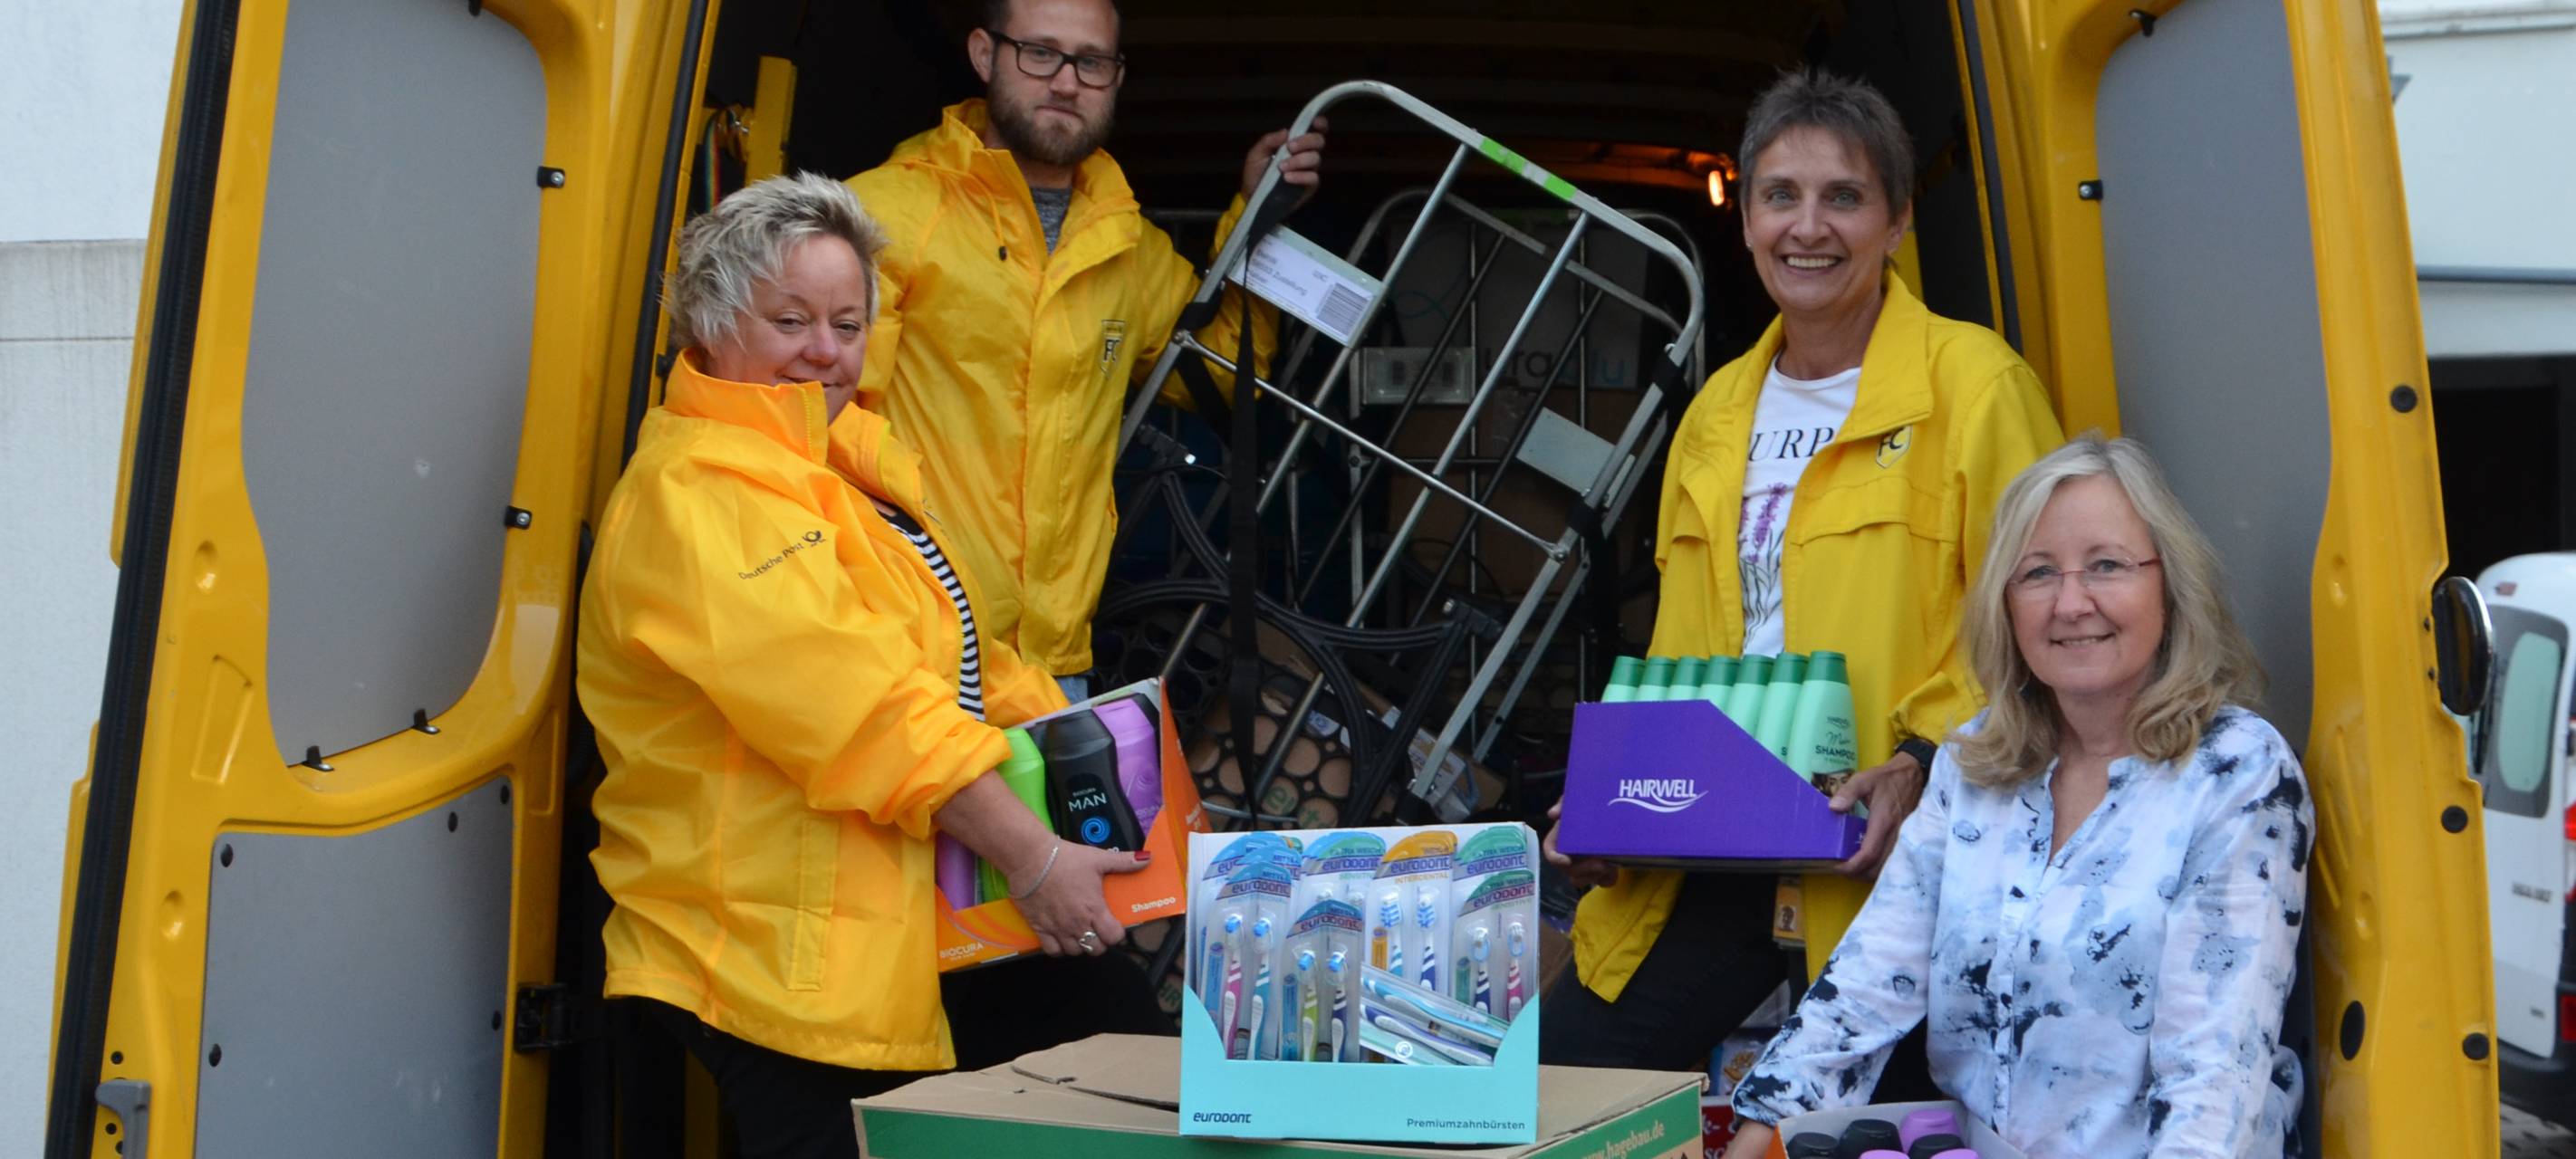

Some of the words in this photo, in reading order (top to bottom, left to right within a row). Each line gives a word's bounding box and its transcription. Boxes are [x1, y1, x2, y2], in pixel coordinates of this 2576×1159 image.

[1878, 426, 1907, 457] FC
[738, 556, 783, 580] Deutsche
[783, 542, 804, 560] Post
[1619, 779, 1697, 799] HAIRWELL
[1068, 792, 1108, 812] MAN
[1131, 896, 1176, 913] Shampoo
[939, 942, 984, 959] BIOCURA
[1407, 1117, 1525, 1130] Premiumzahnbürsten
